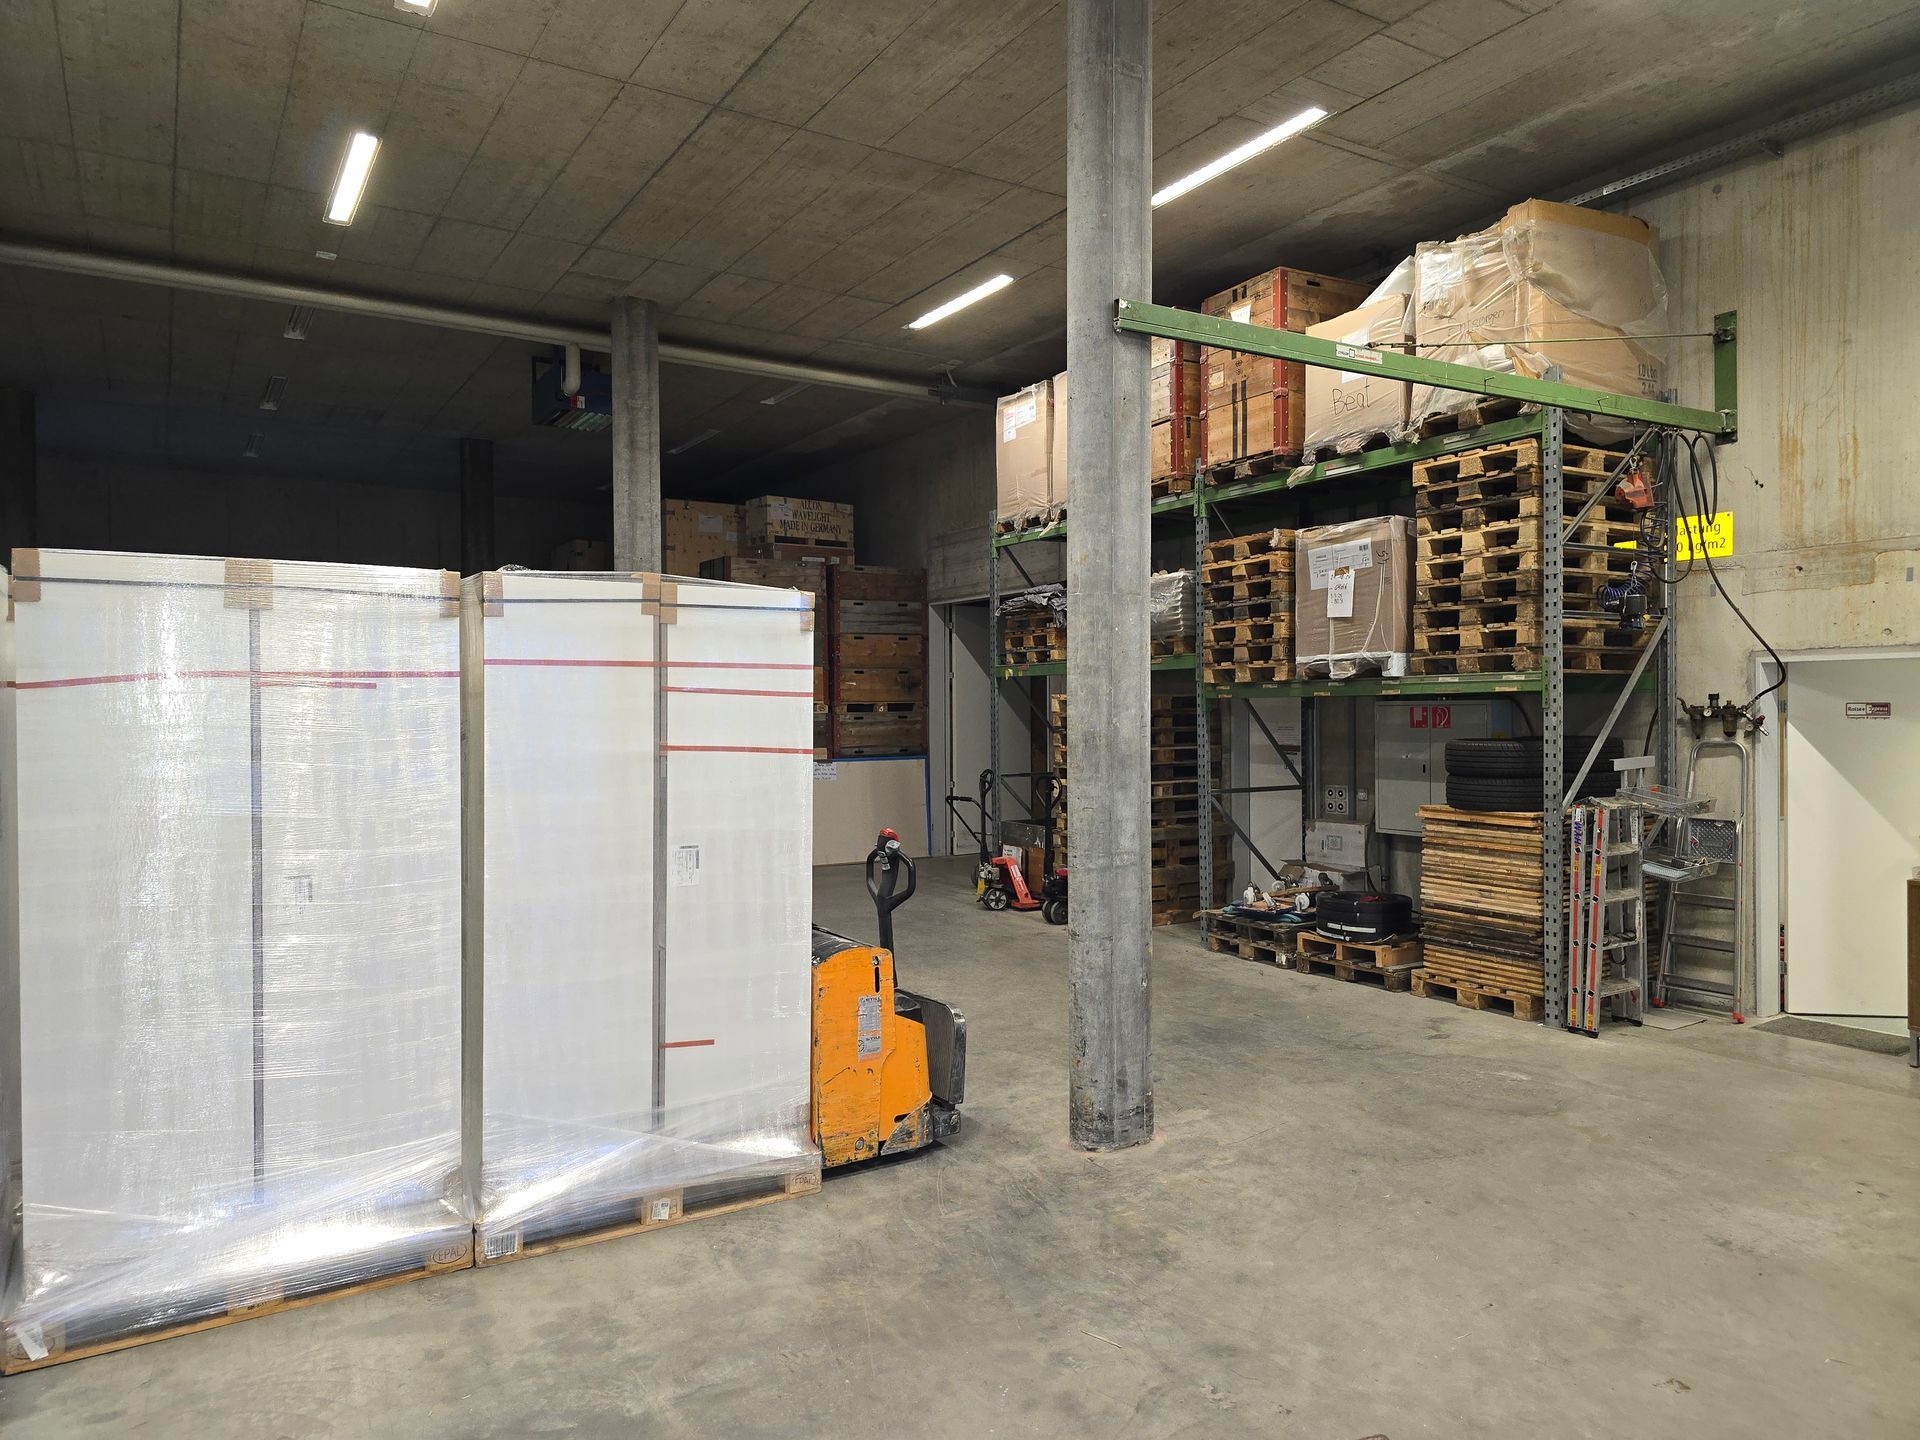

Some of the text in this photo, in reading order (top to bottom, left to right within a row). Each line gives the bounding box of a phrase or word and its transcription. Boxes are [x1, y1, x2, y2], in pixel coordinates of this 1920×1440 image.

[1332, 377, 1371, 415] Beat
[800, 500, 823, 511] ALCON
[792, 510, 830, 523] WAVELIGHT
[780, 519, 842, 535] MADE IN GERMANY
[438, 1246, 461, 1261] EPAL
